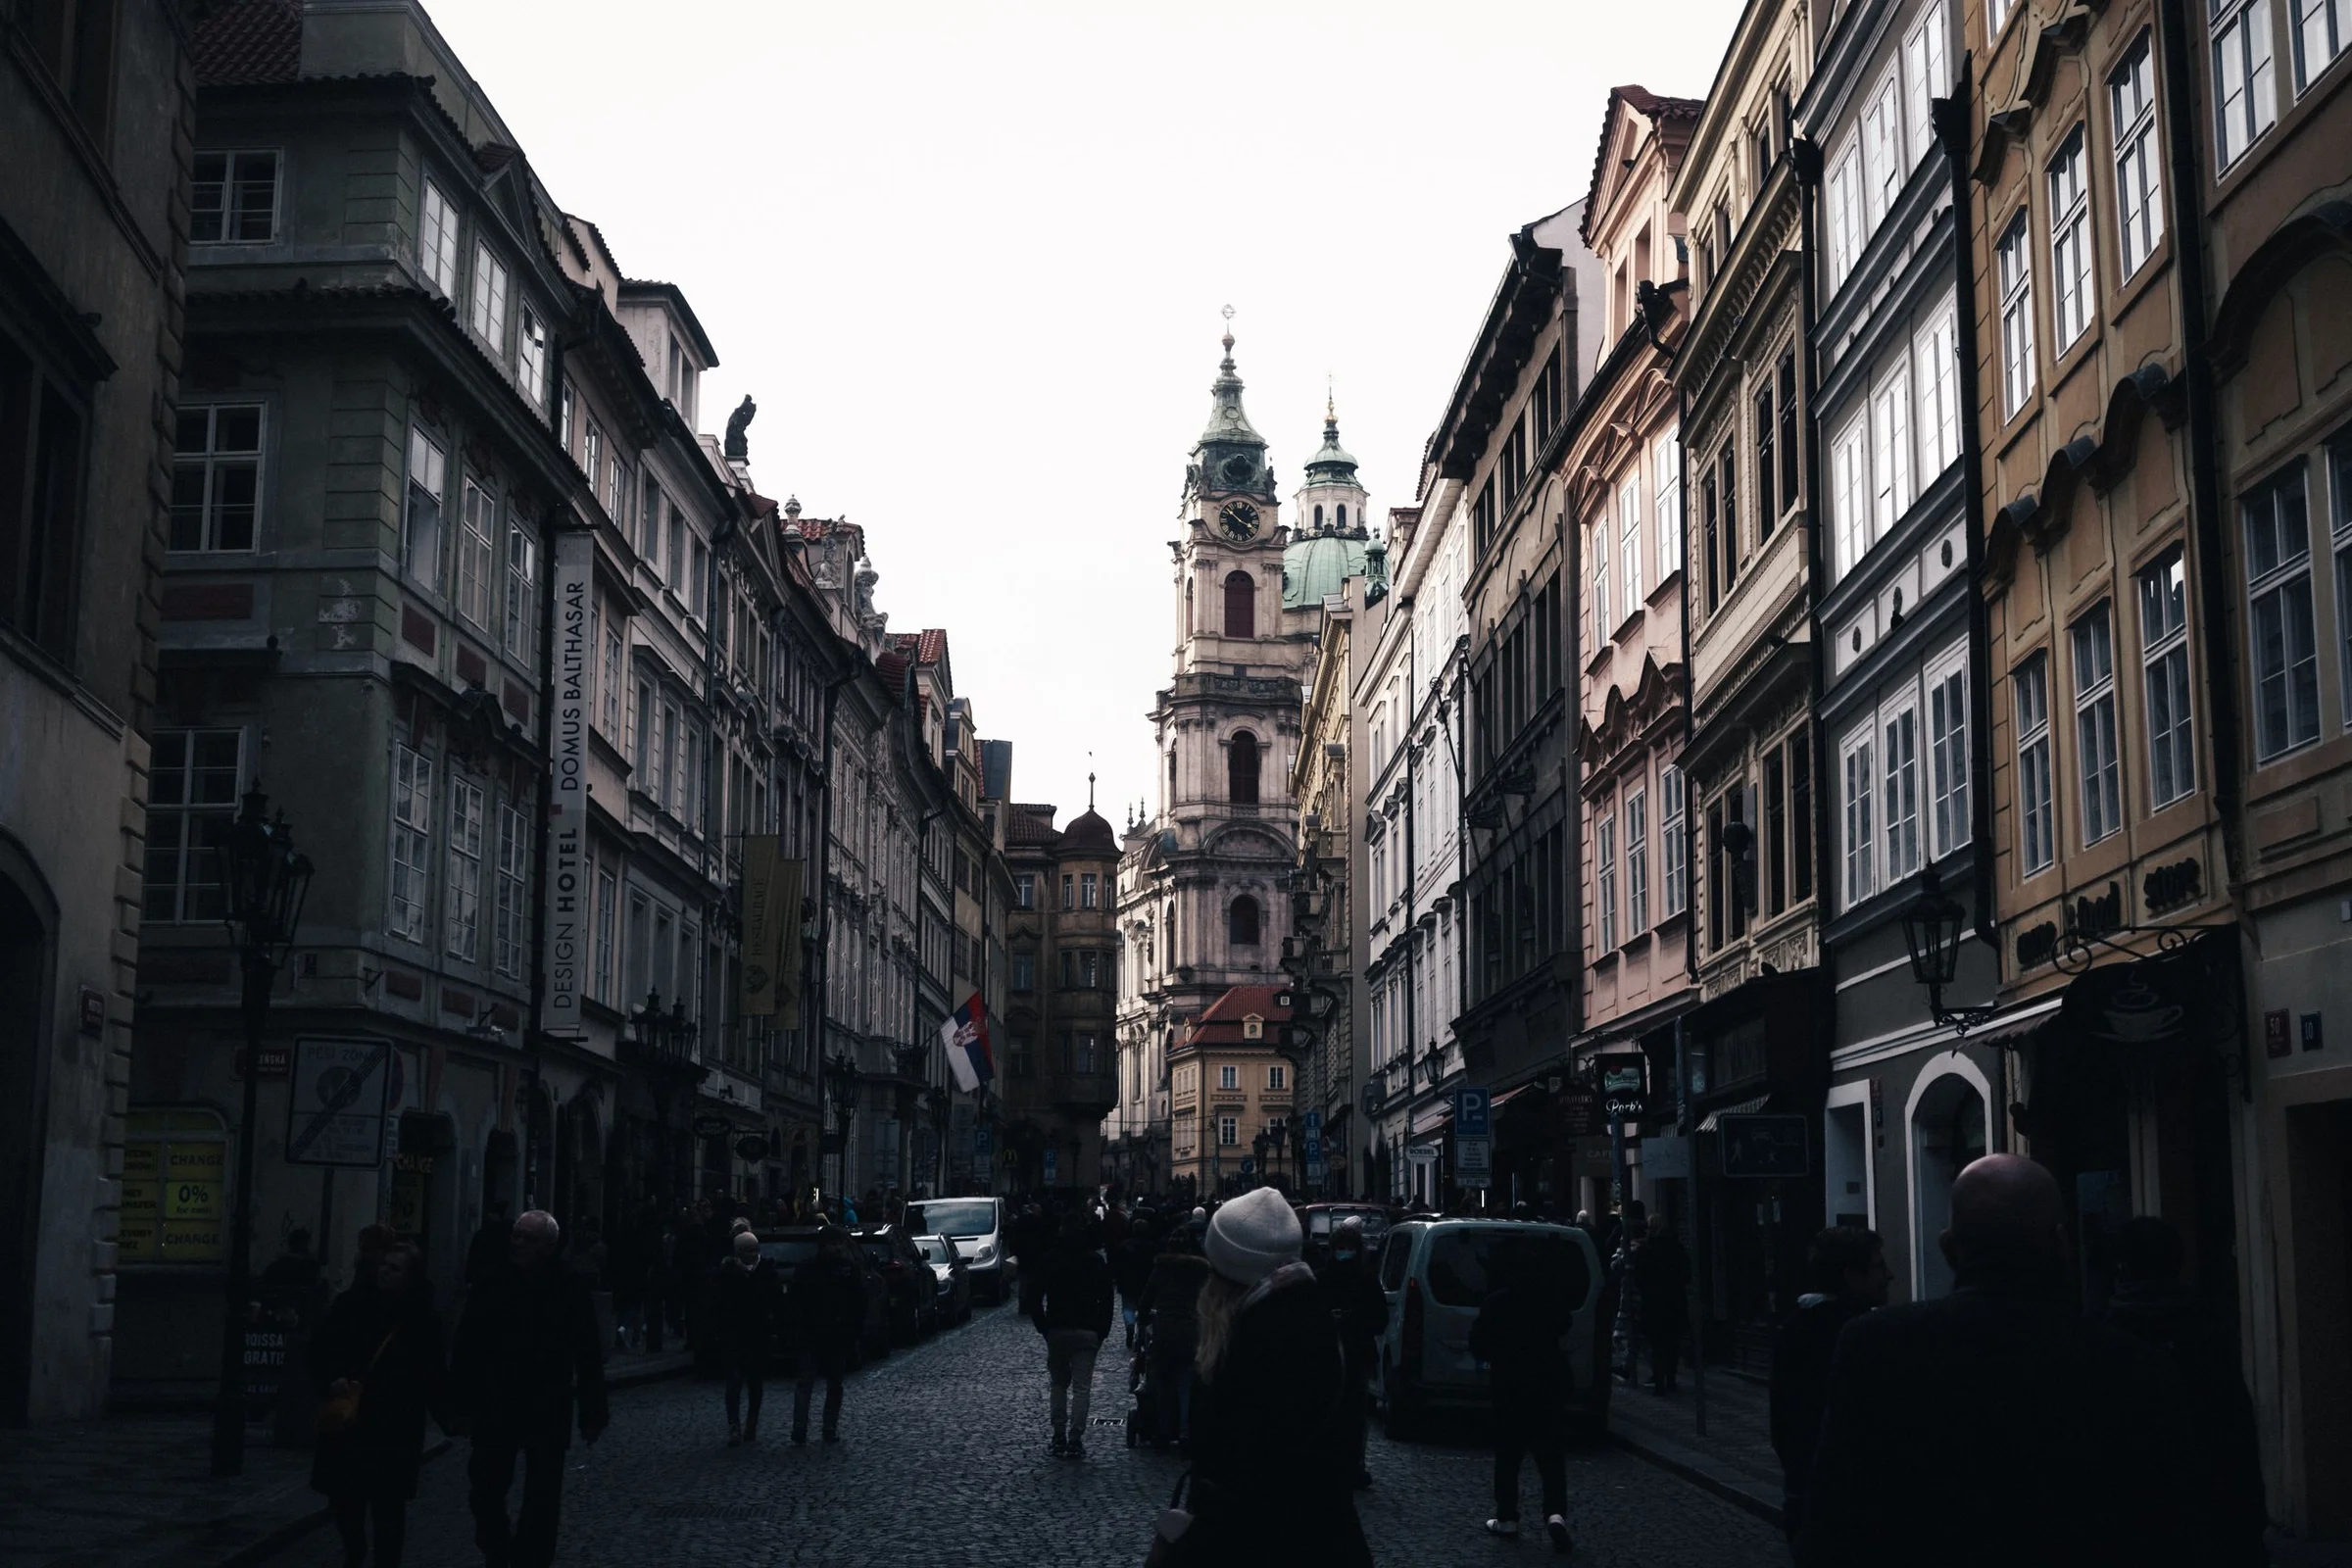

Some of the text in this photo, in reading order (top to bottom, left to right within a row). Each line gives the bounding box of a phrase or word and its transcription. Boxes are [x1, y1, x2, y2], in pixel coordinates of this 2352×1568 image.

[554, 581, 585, 1009] DESIGN HOTEL DOMUS BALTHASAR
[1462, 1093, 1482, 1122] P
[976, 1131, 988, 1147] P
[1308, 1142, 1318, 1155] P
[170, 1154, 223, 1166] CHANGE
[178, 1185, 209, 1202] 0%
[166, 1233, 220, 1245] CHANGE
